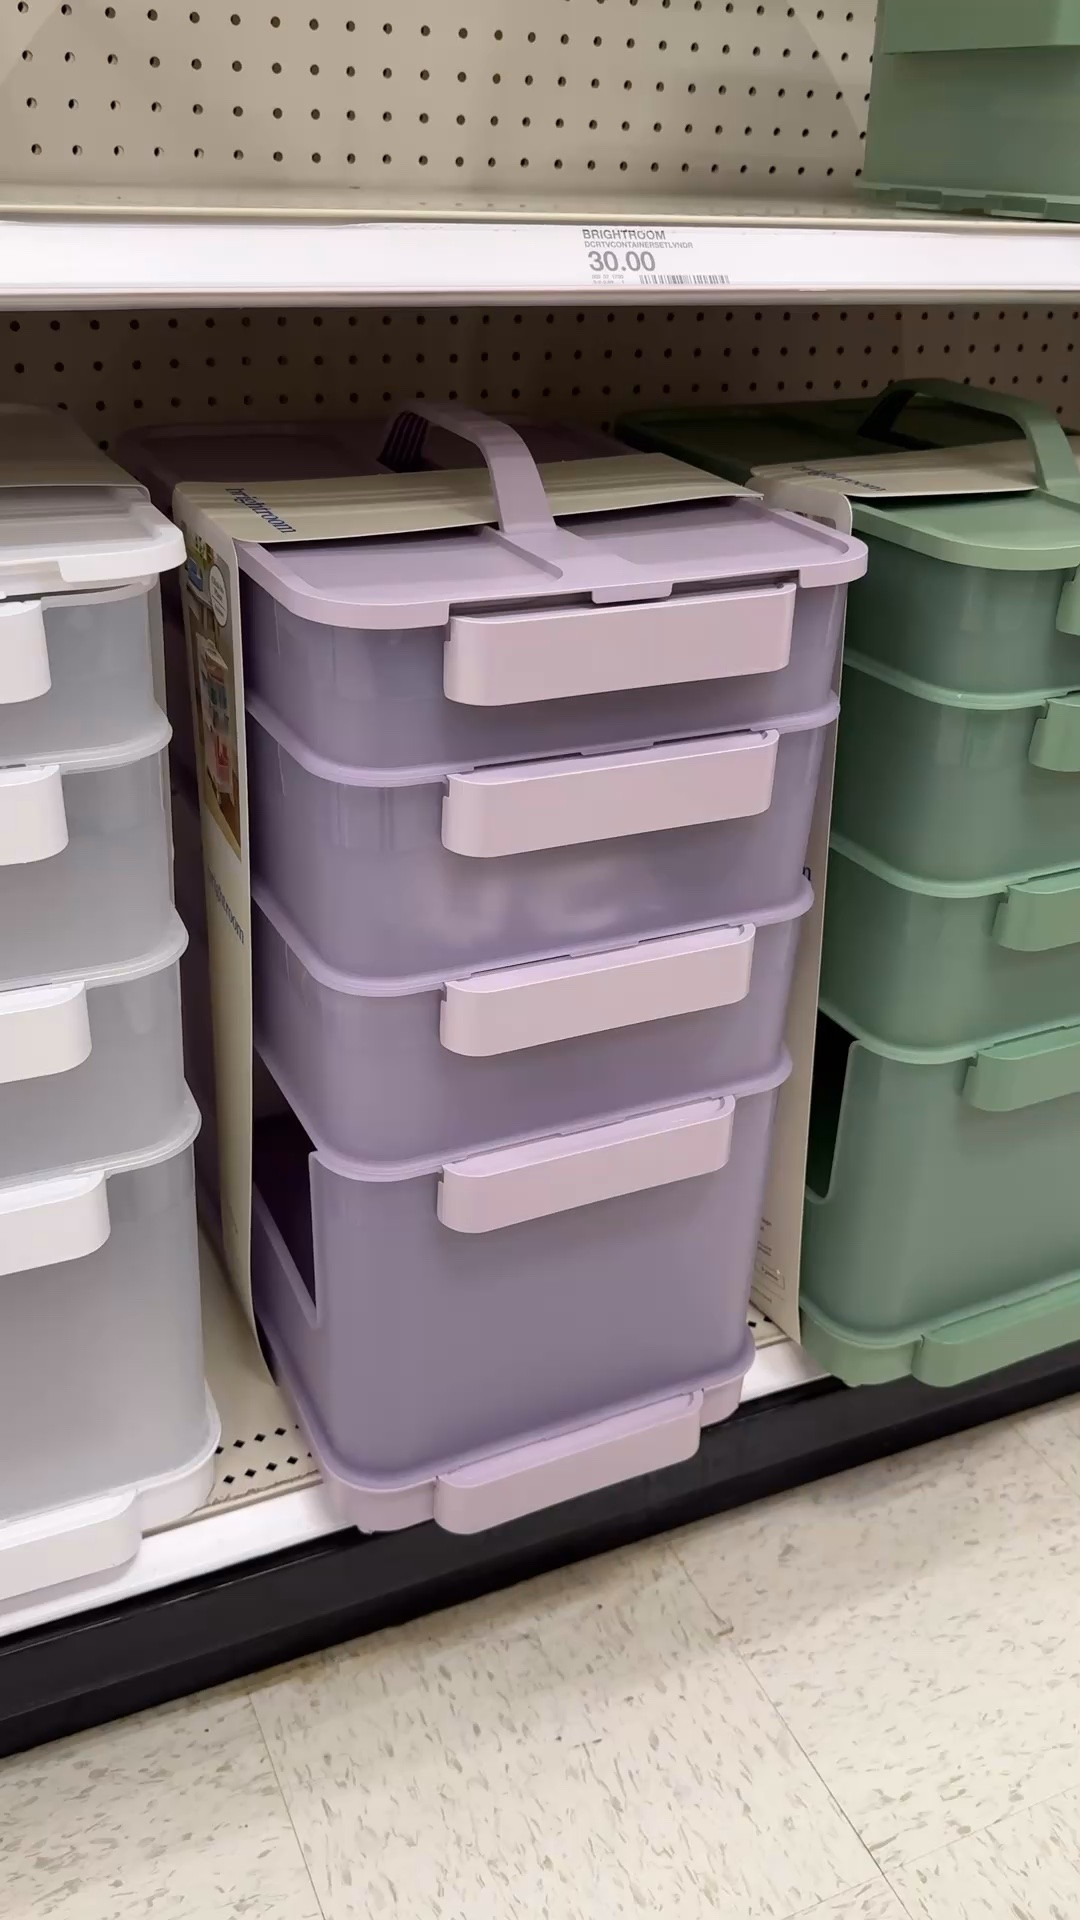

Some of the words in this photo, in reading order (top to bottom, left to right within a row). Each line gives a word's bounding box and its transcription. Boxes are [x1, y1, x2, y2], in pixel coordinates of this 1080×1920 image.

[582, 229, 667, 240] BRIGHTROOM
[588, 250, 656, 272] 30.00
[225, 487, 297, 534] brightroom
